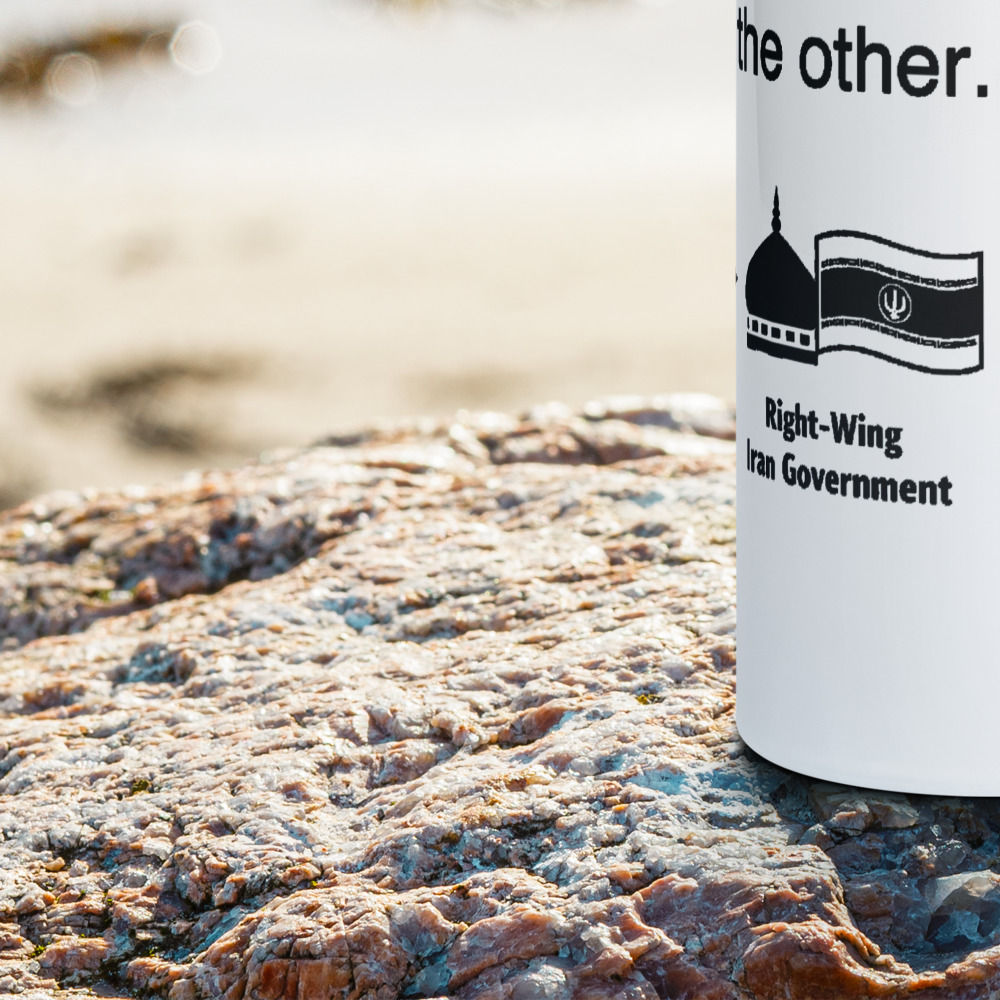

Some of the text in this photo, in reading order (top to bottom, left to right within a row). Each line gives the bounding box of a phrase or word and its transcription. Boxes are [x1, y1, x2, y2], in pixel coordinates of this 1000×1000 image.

[736, 5, 989, 98] the other.
[765, 396, 904, 460] Right-Wing
[746, 437, 953, 507] Iran Government
